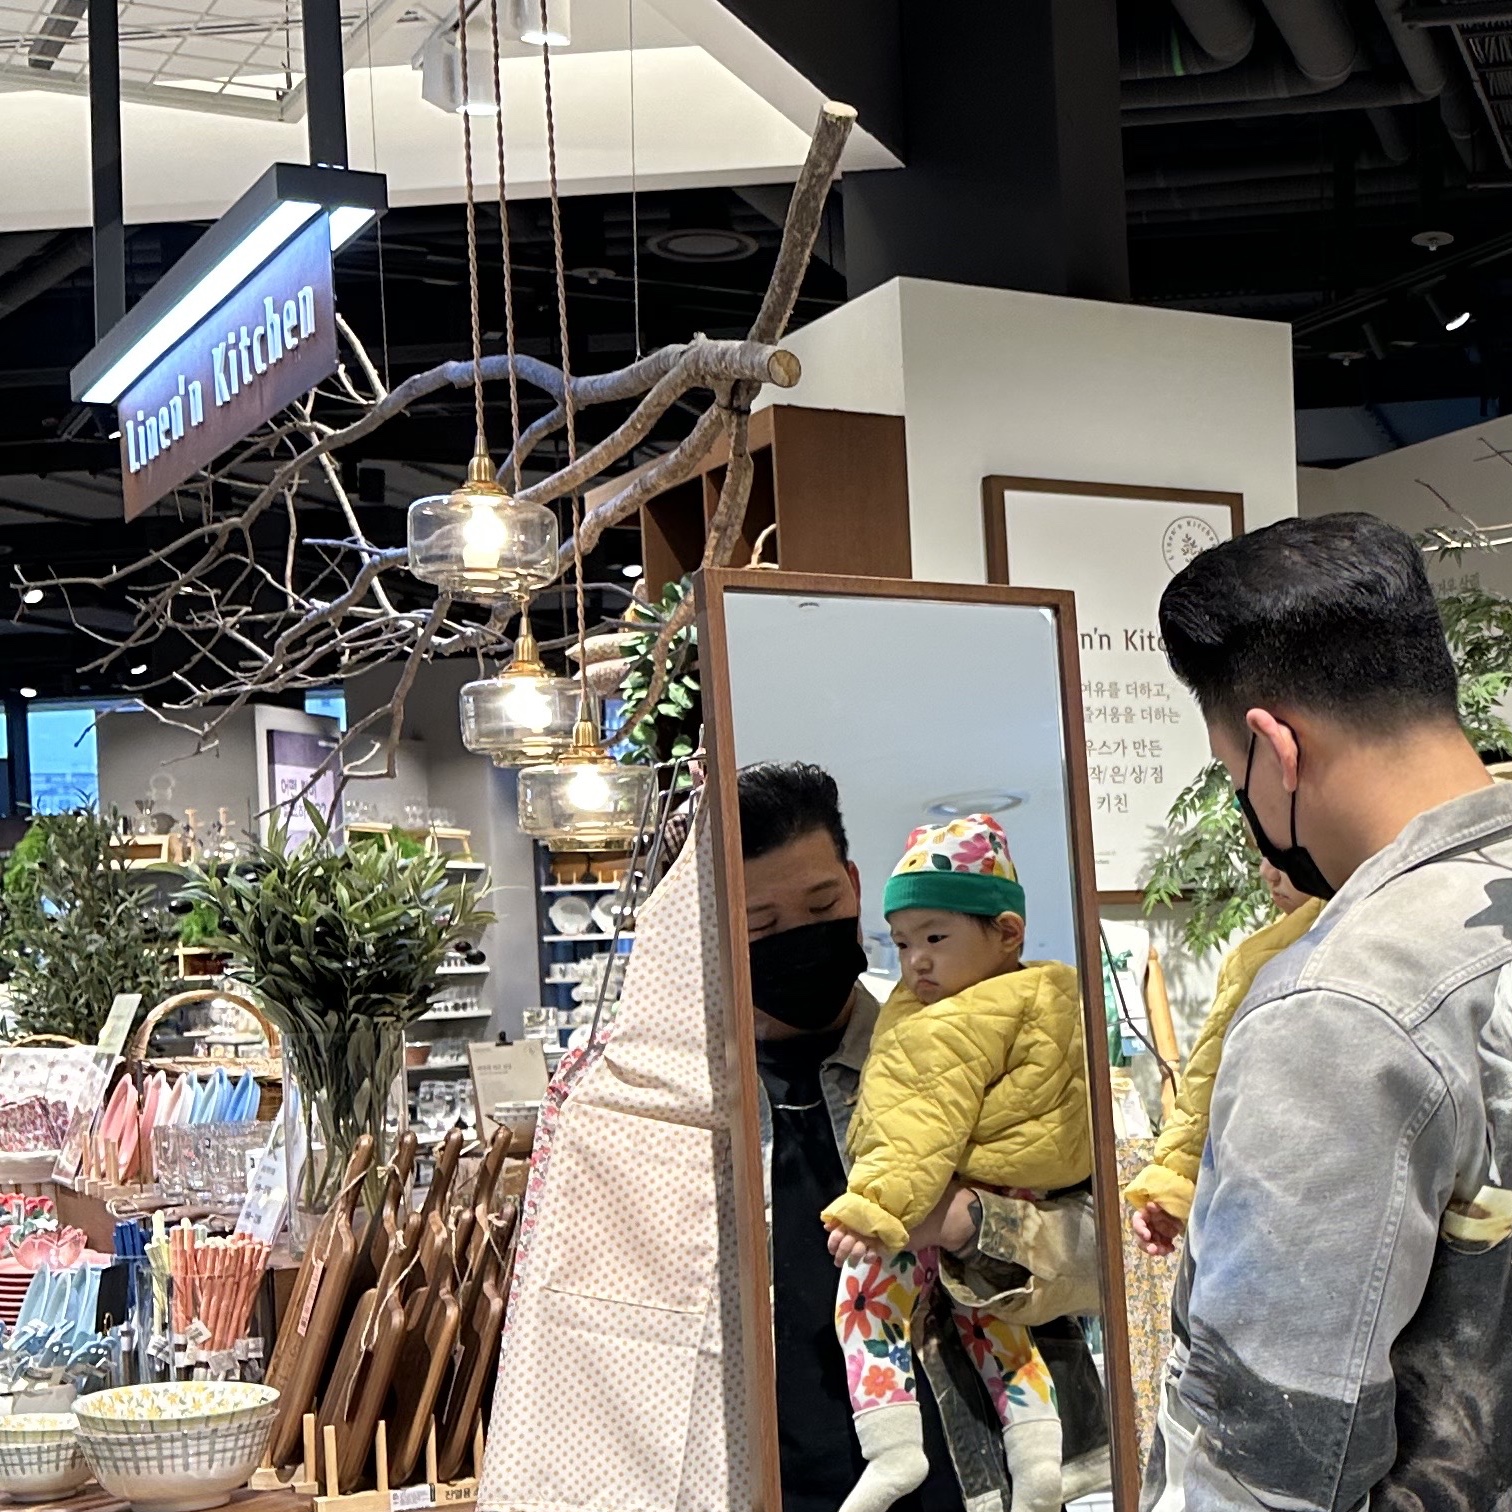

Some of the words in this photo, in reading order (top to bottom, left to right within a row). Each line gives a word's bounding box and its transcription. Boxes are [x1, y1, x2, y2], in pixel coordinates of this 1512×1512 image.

[125, 373, 204, 474] Linen'n
[211, 285, 316, 407] Kitchen
[1123, 628, 1167, 652] Kitc
[1126, 680, 1170, 701] 더하고,
[1140, 705, 1181, 724] 더하는
[1086, 738, 1127, 758] 우스가
[1133, 738, 1162, 758] 만든
[1097, 793, 1129, 813] 키친
